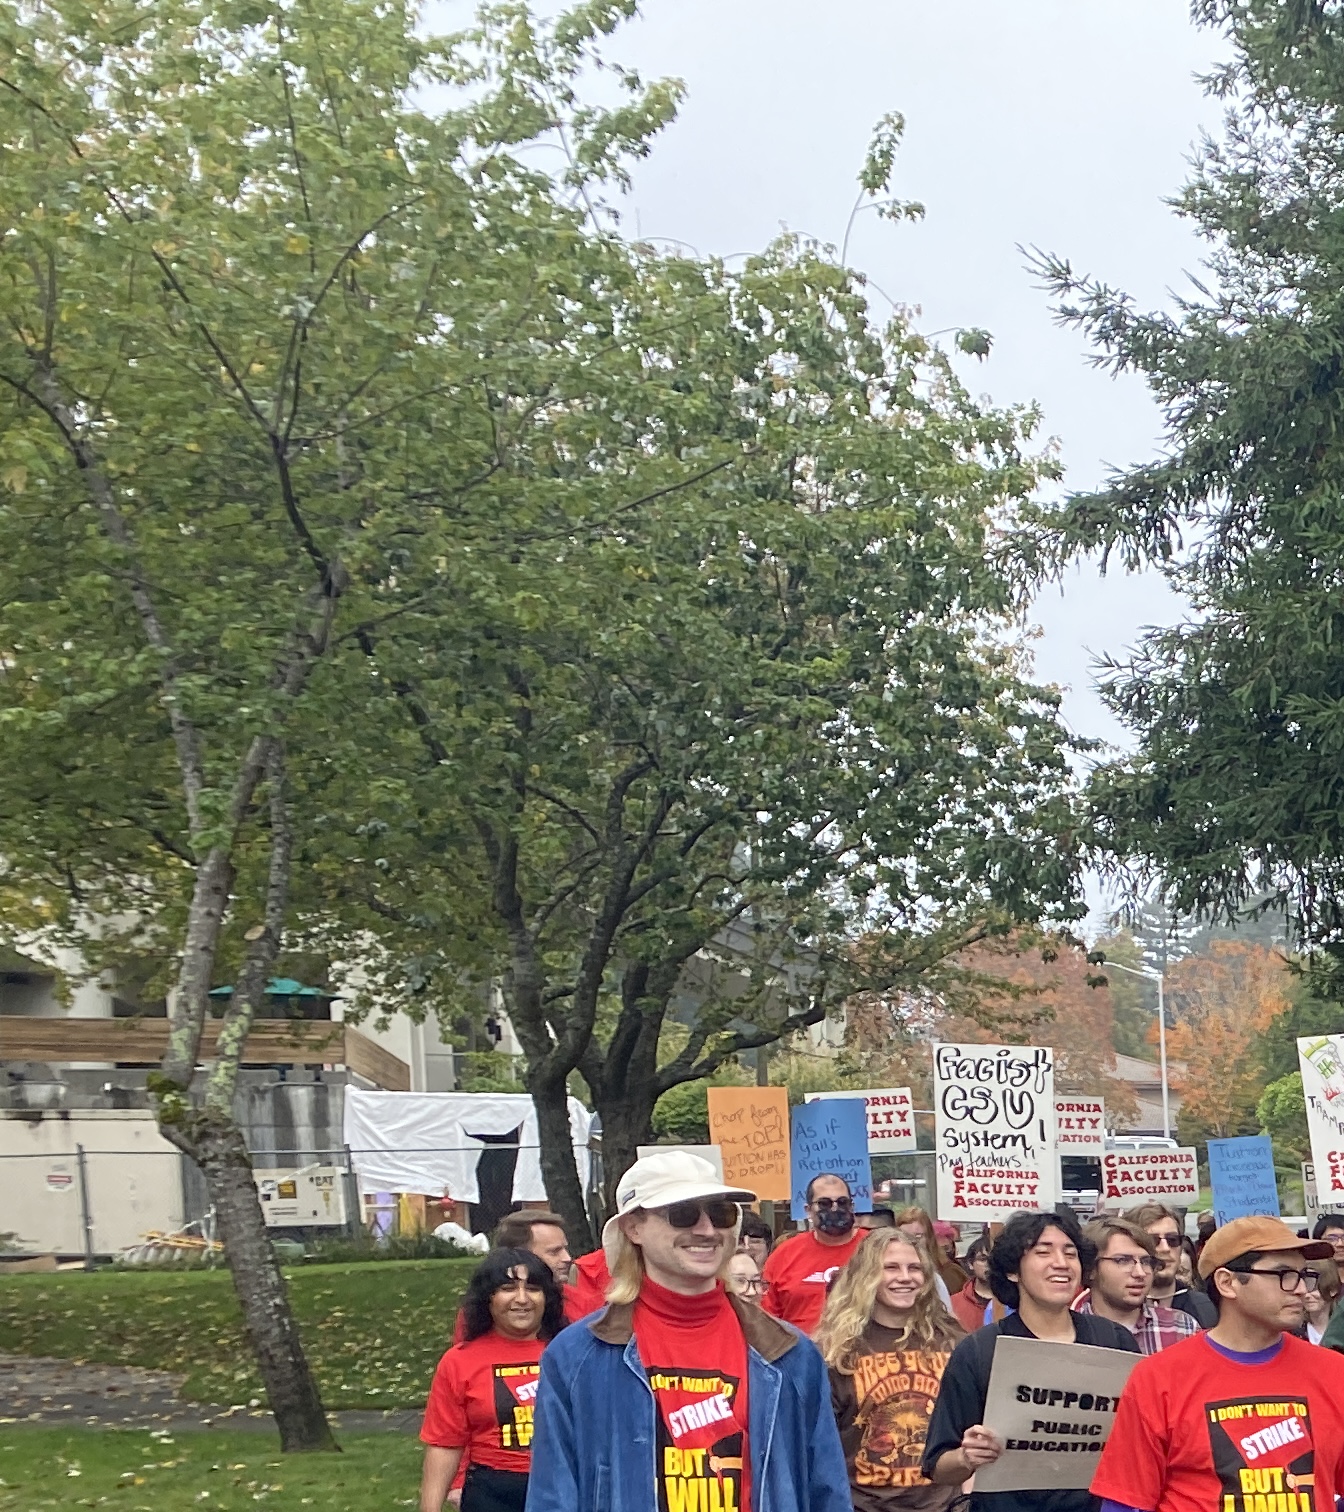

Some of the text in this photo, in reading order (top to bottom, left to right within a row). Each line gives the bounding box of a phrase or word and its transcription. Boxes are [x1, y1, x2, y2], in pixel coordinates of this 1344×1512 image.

[937, 1047, 1050, 1093] Facist
[943, 1085, 1034, 1128] CSU
[866, 1110, 908, 1124] LTY
[1104, 1153, 1194, 1168] CALIFORNIA
[953, 1166, 1039, 1180] CALIFORNIA
[1106, 1168, 1193, 1183] FACULTY
[954, 1181, 1037, 1194] FACULTY
[1105, 1183, 1195, 1198] ASSOCIATION
[953, 1196, 1039, 1208] ASSOCIATION
[682, 1376, 720, 1393] WANT
[668, 1393, 733, 1439] STRIKE
[1210, 1403, 1307, 1423] I DON'T WANT TO
[1031, 1420, 1102, 1435] PUBLIC
[1240, 1417, 1304, 1460] STRIKE
[664, 1447, 706, 1477] BUT
[1239, 1467, 1284, 1493] BUT
